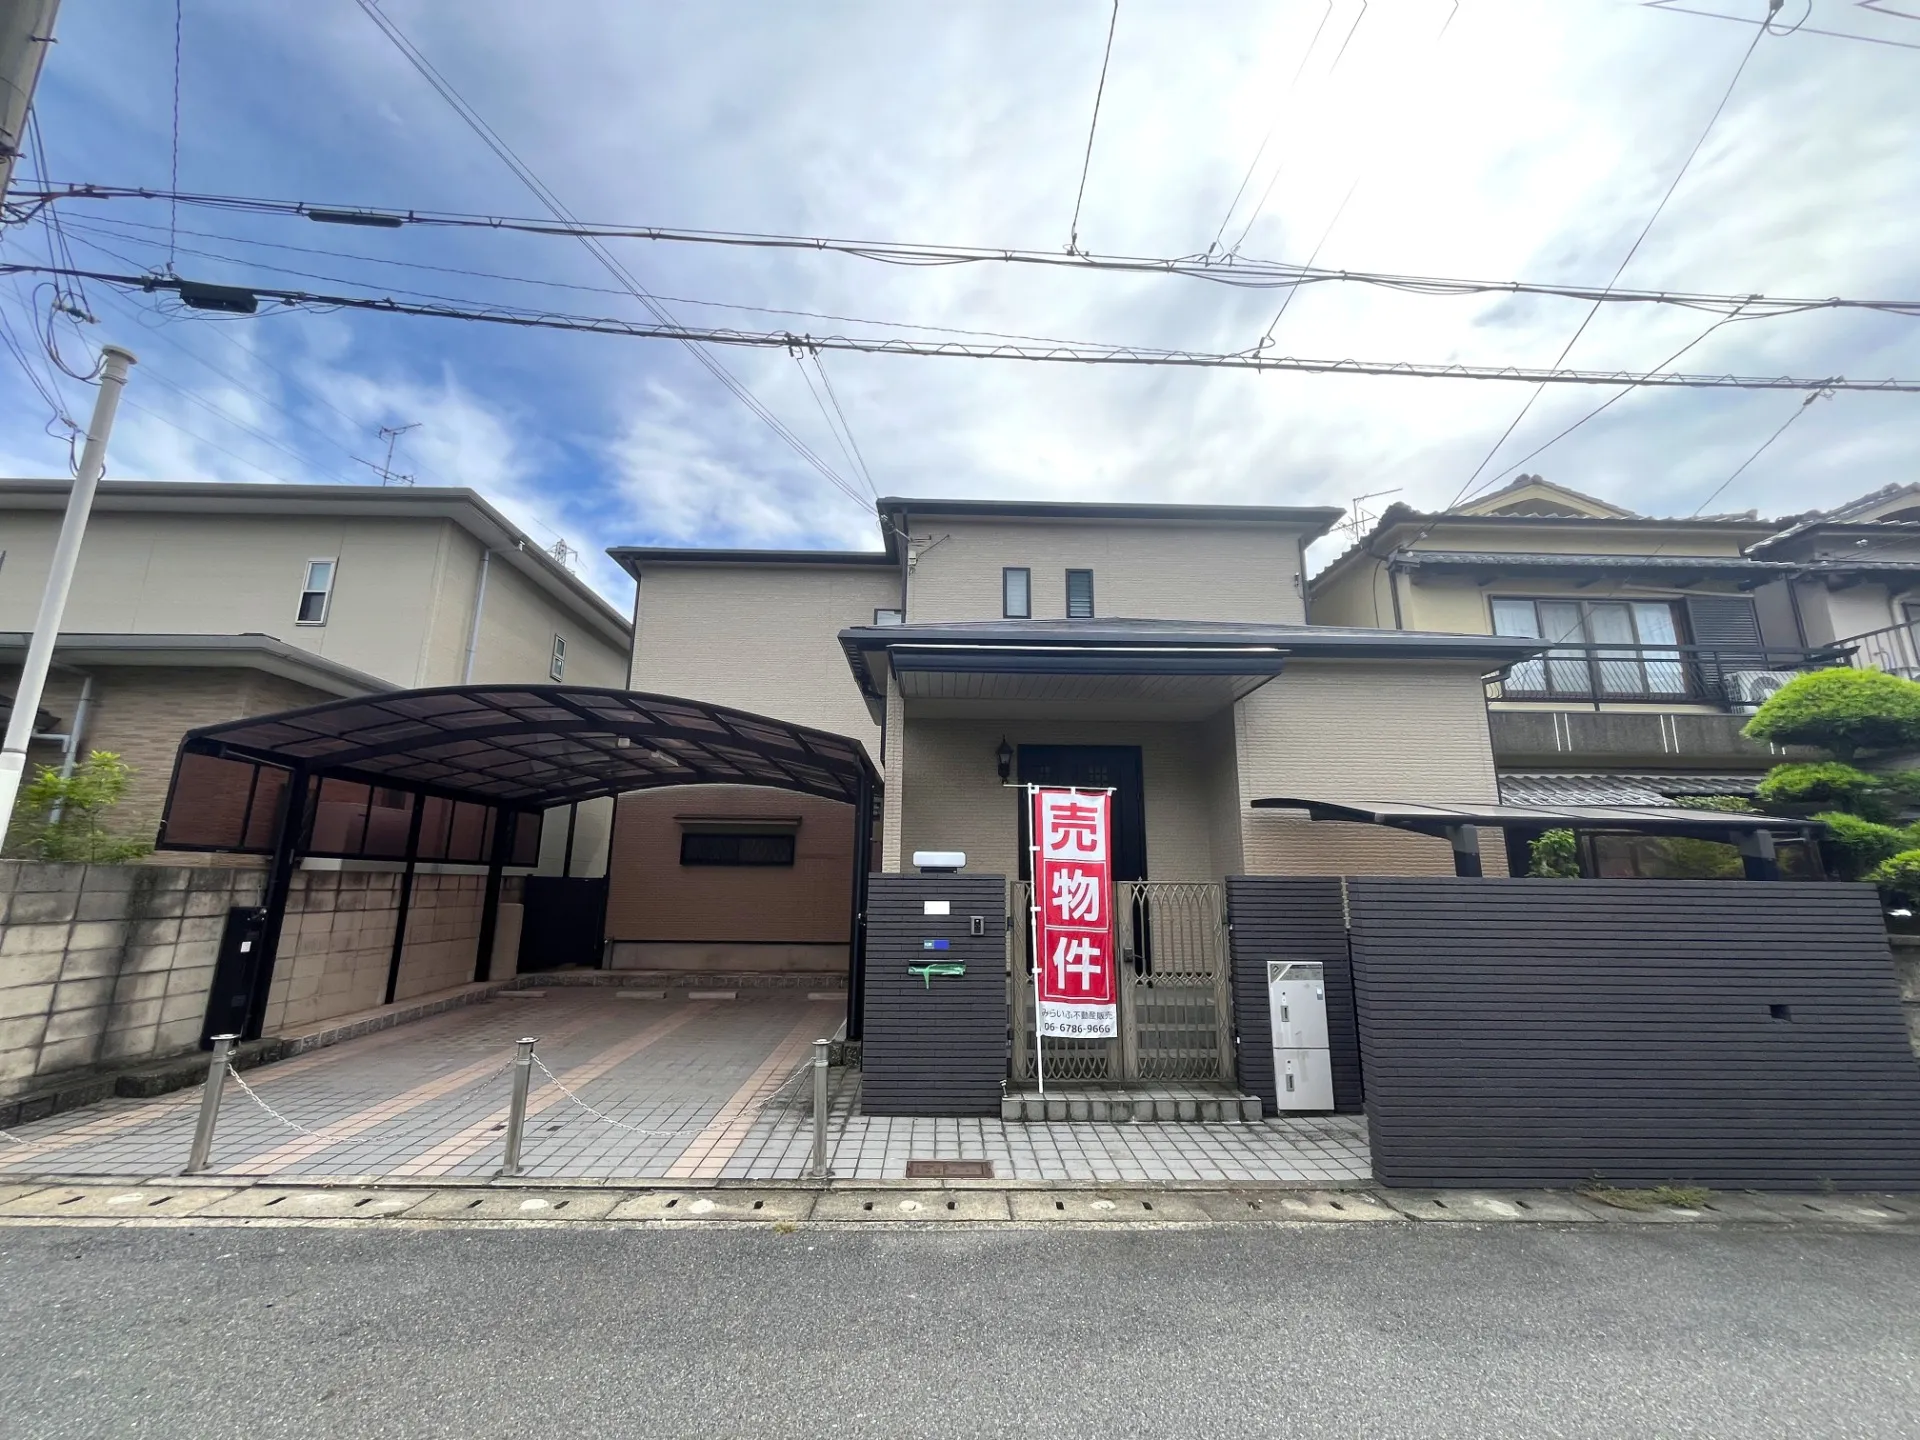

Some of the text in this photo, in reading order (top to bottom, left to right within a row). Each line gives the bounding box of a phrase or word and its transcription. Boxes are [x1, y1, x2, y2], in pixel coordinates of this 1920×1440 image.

[1050, 802, 1101, 991] 売物件
[1044, 1022, 1111, 1033] 06-6786-9666
